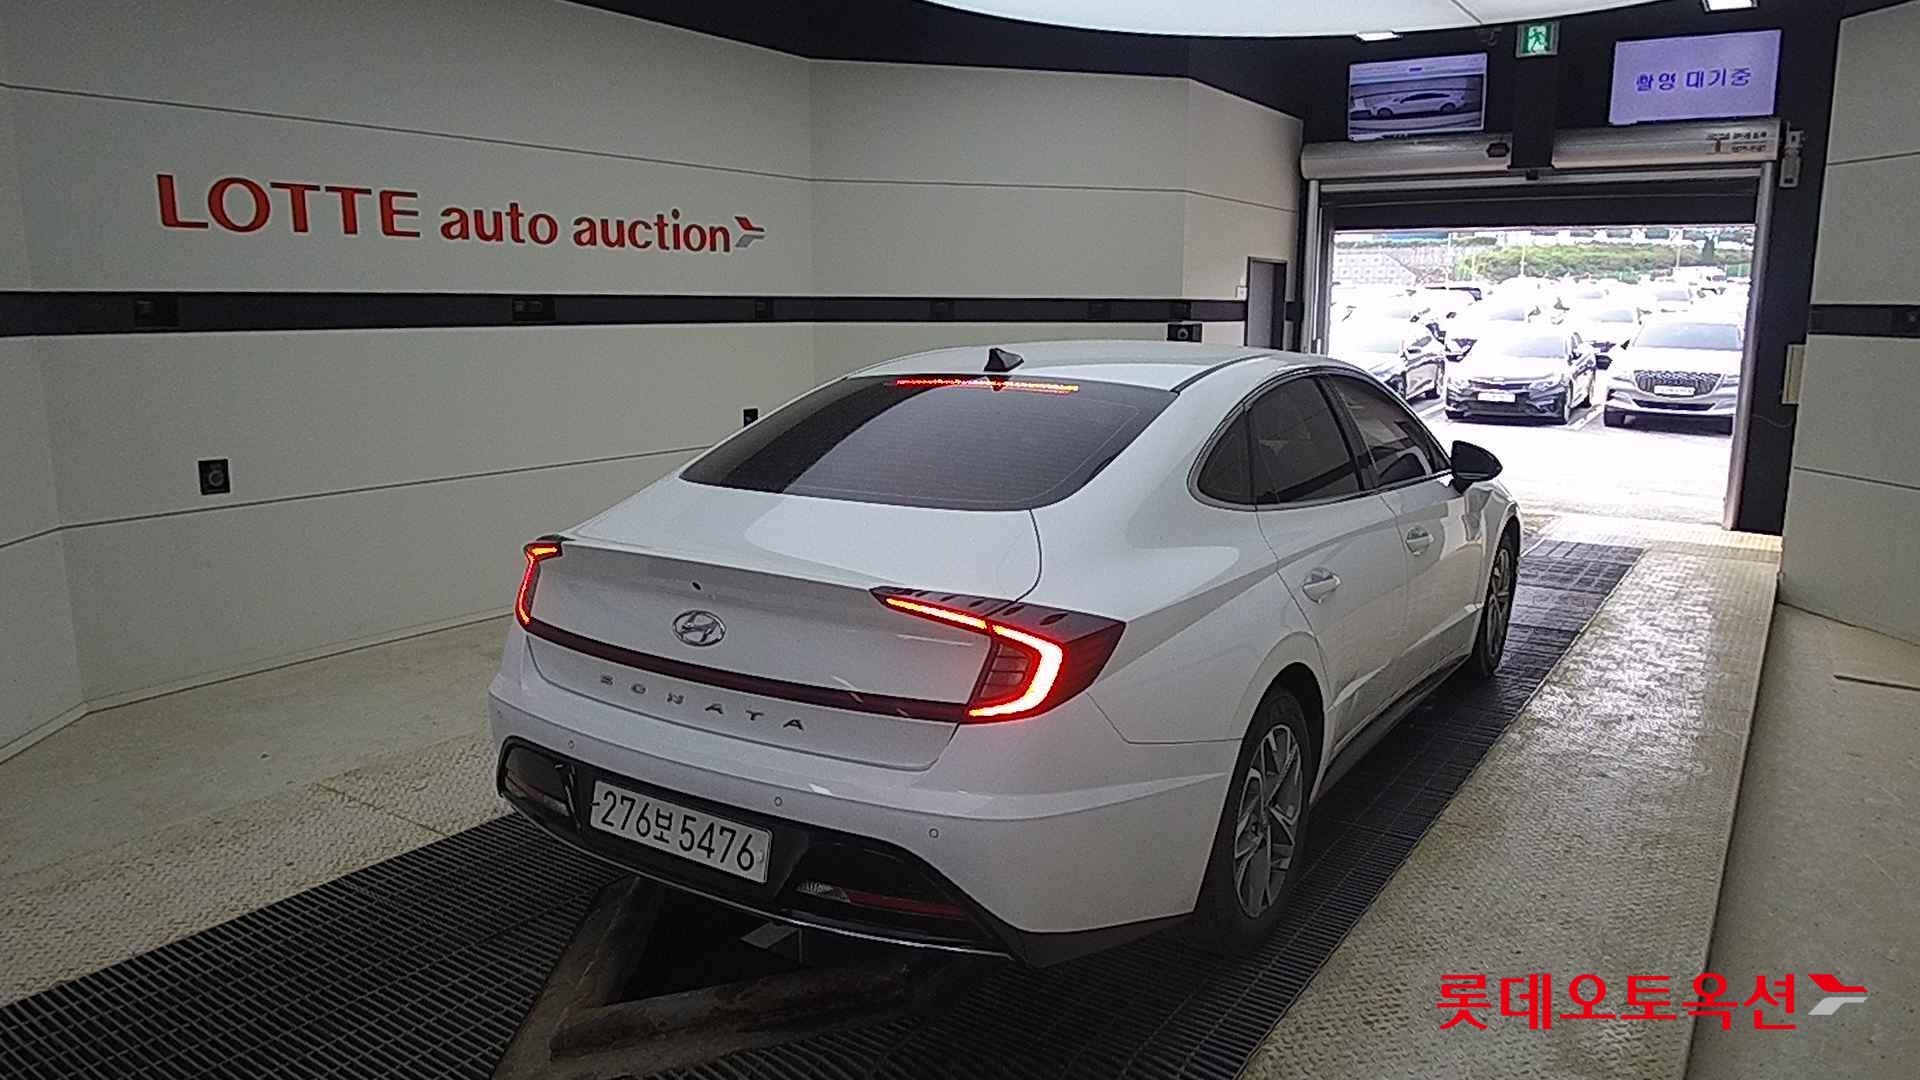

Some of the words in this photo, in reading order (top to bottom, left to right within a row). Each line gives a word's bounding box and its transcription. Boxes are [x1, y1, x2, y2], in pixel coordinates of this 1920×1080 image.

[1686, 68, 1751, 89] 대기중
[156, 174, 421, 238] LOTTE
[440, 203, 558, 245] auto
[573, 209, 731, 253] auction
[600, 674, 804, 731] SONATA
